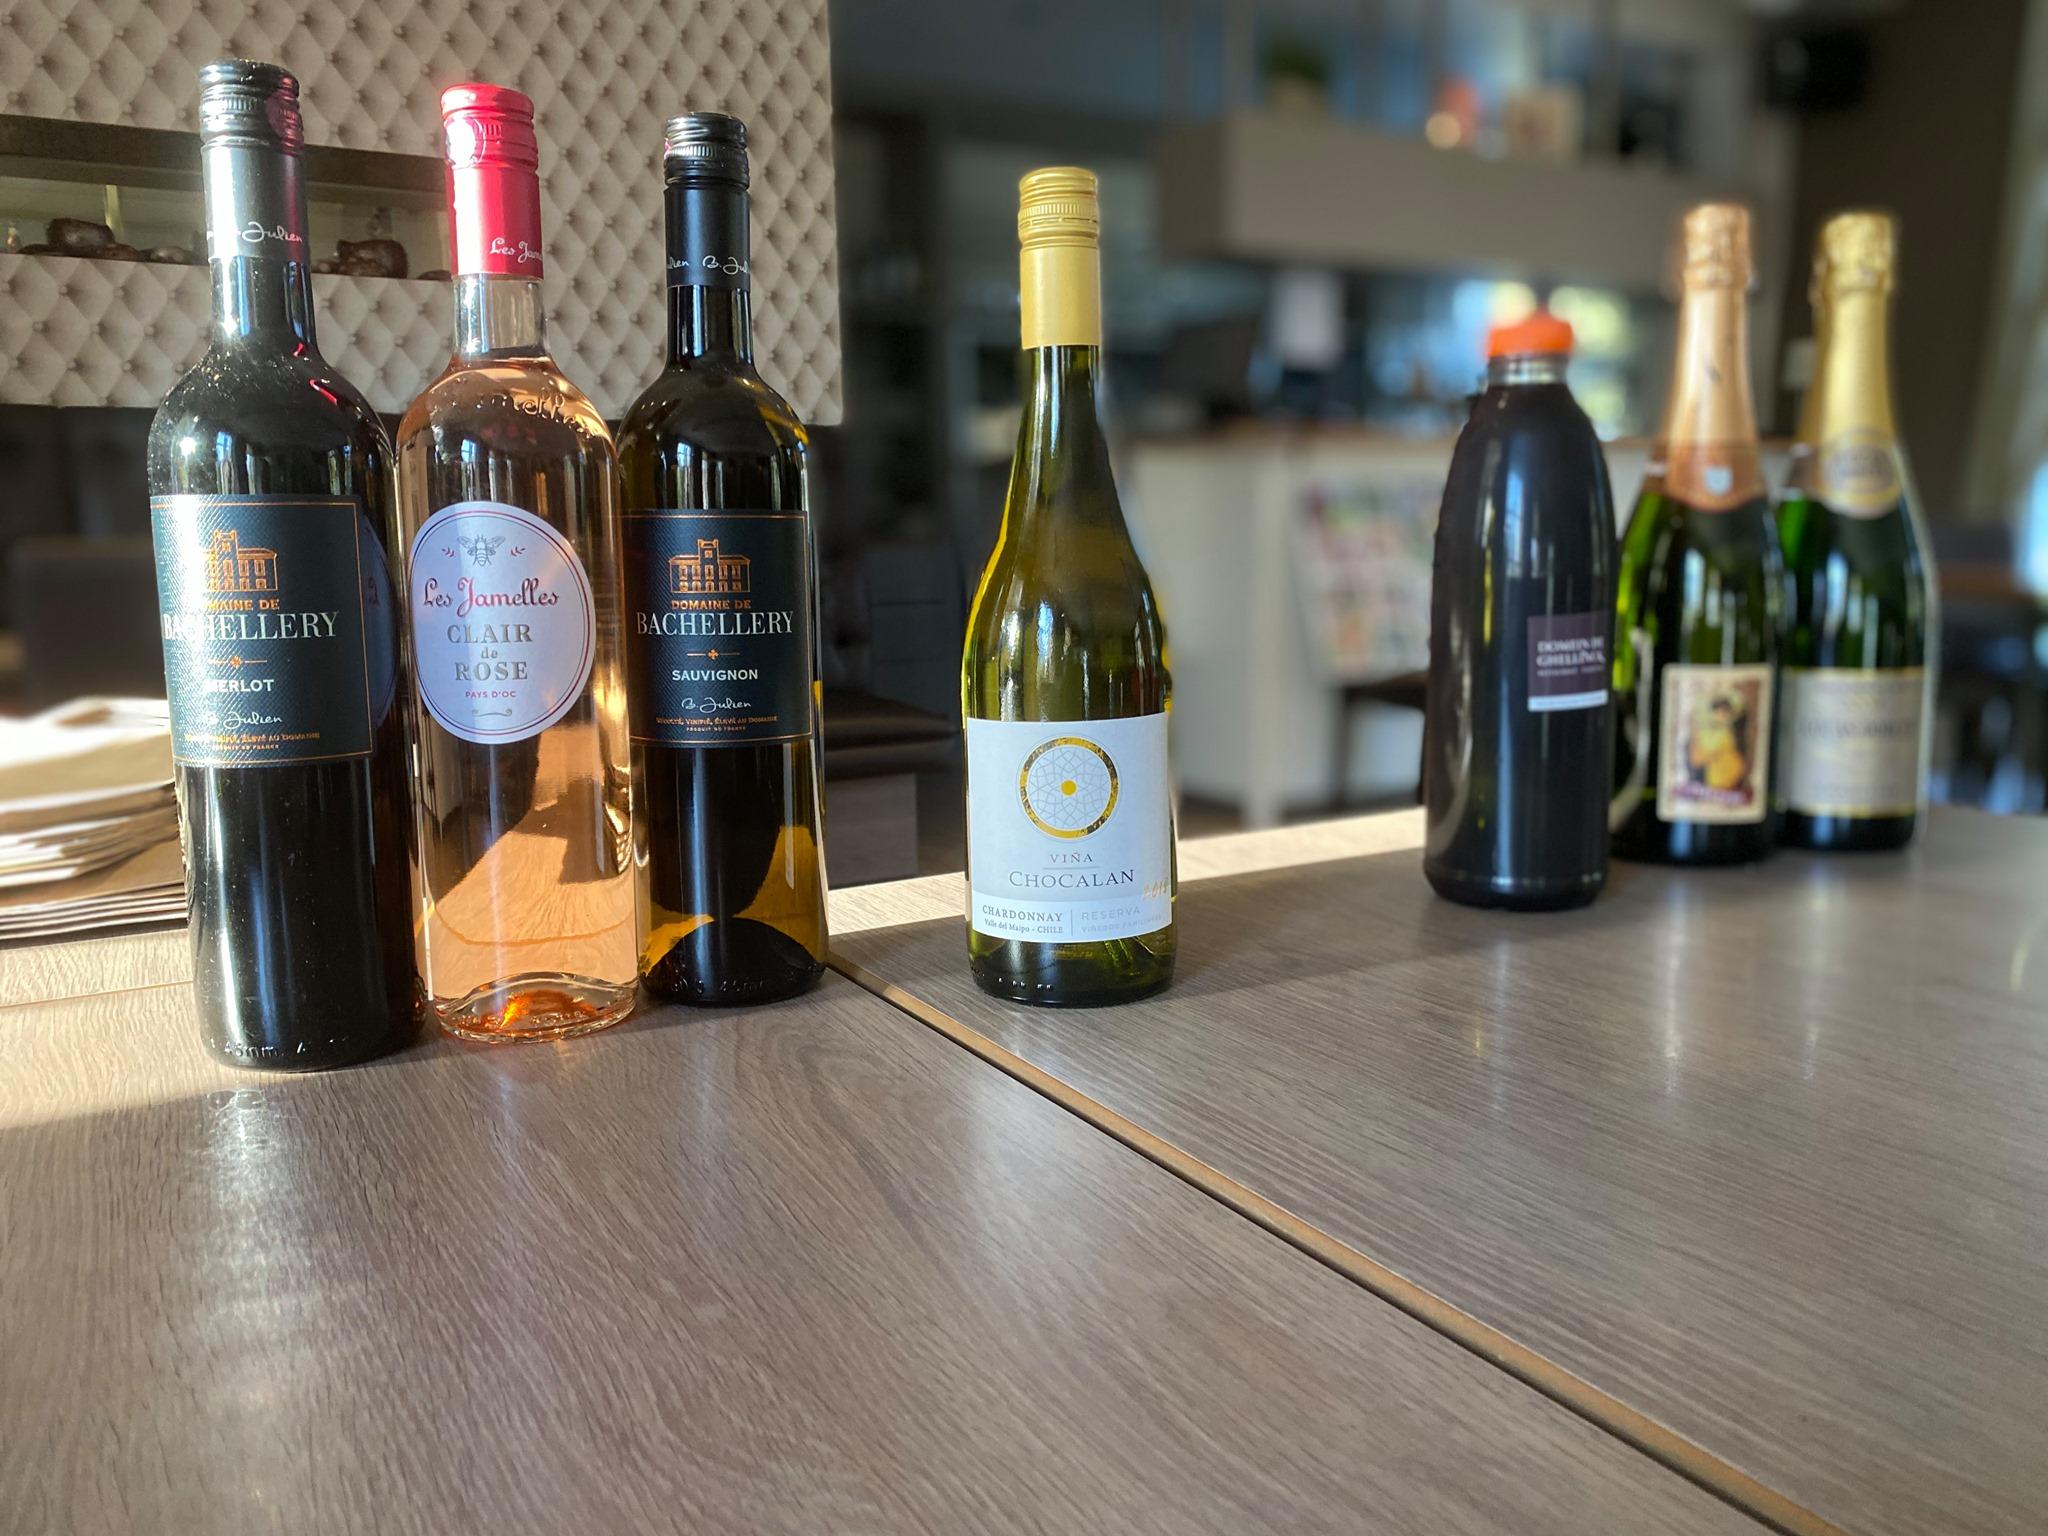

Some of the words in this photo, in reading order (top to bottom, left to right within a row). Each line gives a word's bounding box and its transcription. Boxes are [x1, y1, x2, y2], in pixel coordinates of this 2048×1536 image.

[490, 236, 516, 256] Les
[259, 599, 280, 611] DE
[424, 577, 453, 607] Les
[457, 576, 560, 618] Jamelles
[671, 600, 730, 610] DOMAINE
[734, 600, 752, 610] DE
[637, 610, 794, 636] BACHELLERY
[447, 623, 533, 644] CLAIR
[481, 646, 499, 659] de
[455, 661, 529, 681] ROSE
[672, 668, 759, 682] SAUVIGNON
[465, 691, 489, 699] PAYS
[491, 690, 518, 699] D'OC
[699, 696, 752, 714] Julien
[222, 711, 283, 730] Julien
[1050, 851, 1094, 864] VIÑA
[1009, 869, 1135, 888] CHOCALAN
[982, 905, 1063, 922] CHARDONNAY
[1081, 906, 1140, 921] RESERVA
[1037, 925, 1064, 934] CHILE
